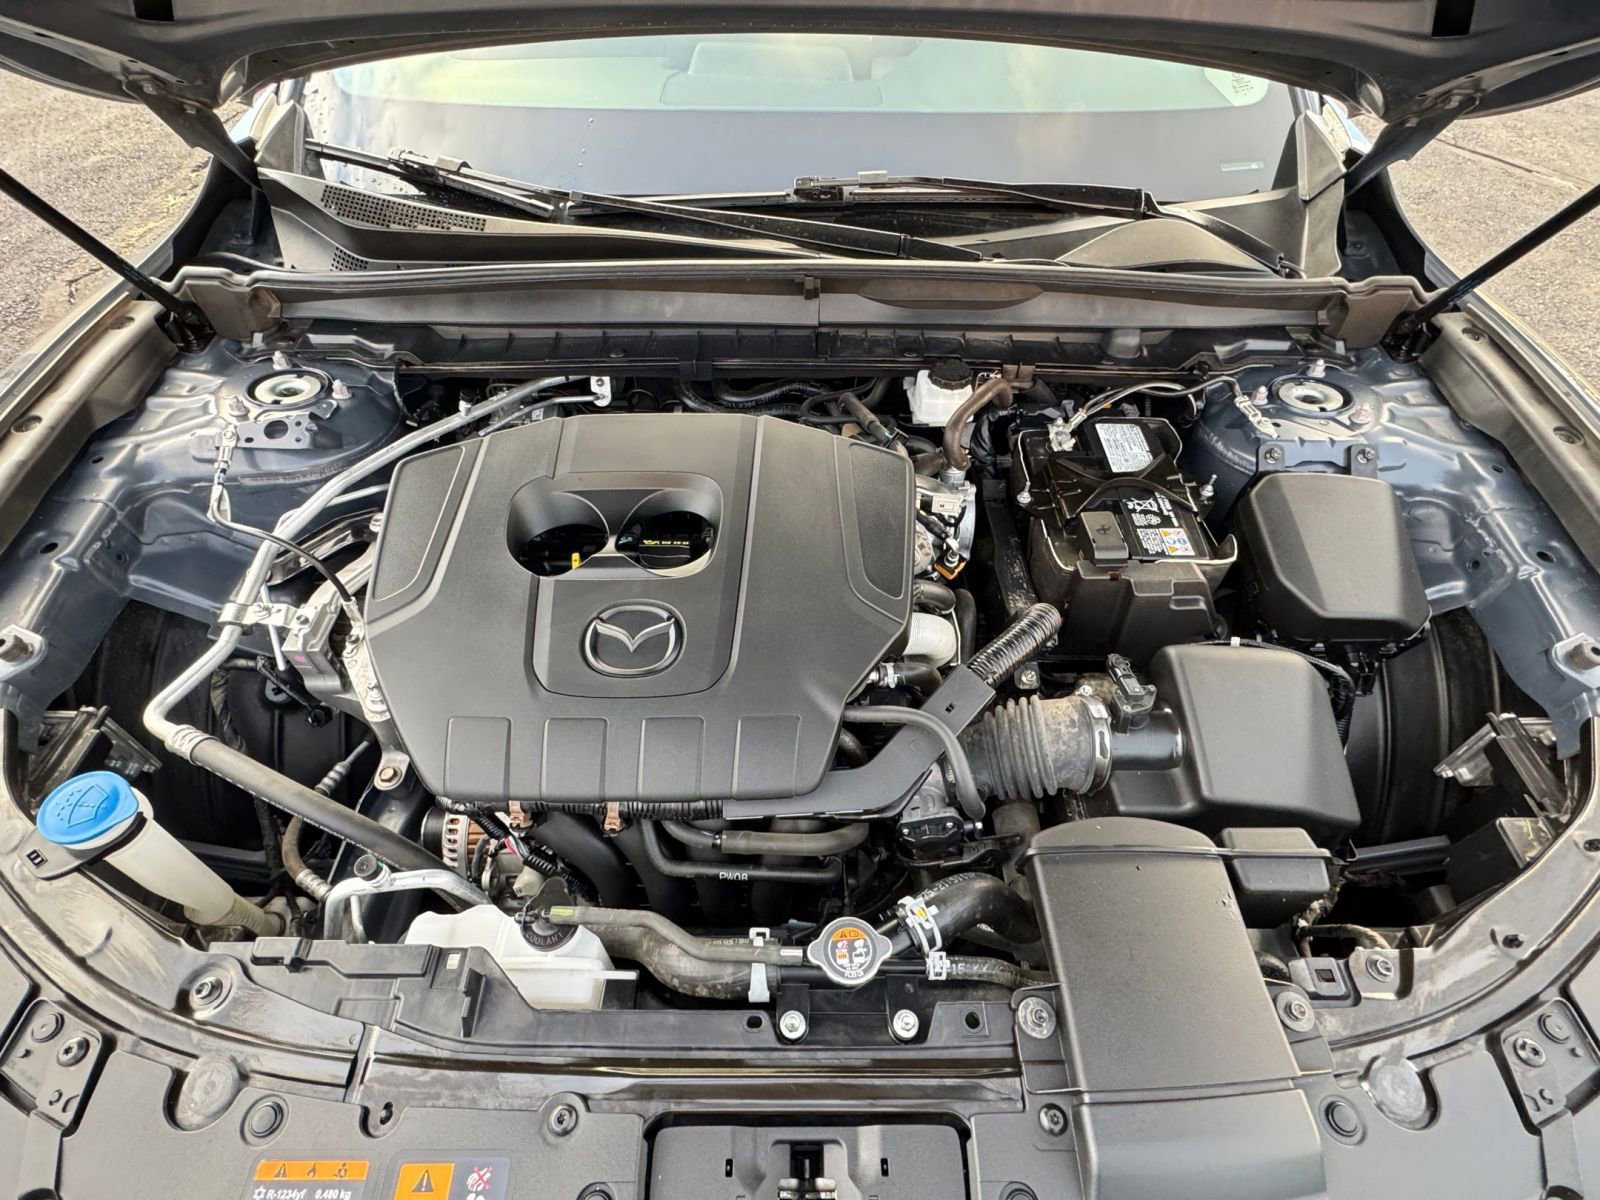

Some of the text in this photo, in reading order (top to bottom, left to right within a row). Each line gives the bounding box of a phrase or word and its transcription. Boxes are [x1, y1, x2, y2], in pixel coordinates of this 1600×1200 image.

[525, 931, 565, 946] COOLANT
[266, 1188, 307, 1200] R-1234yf
[339, 1189, 352, 1200] kg
